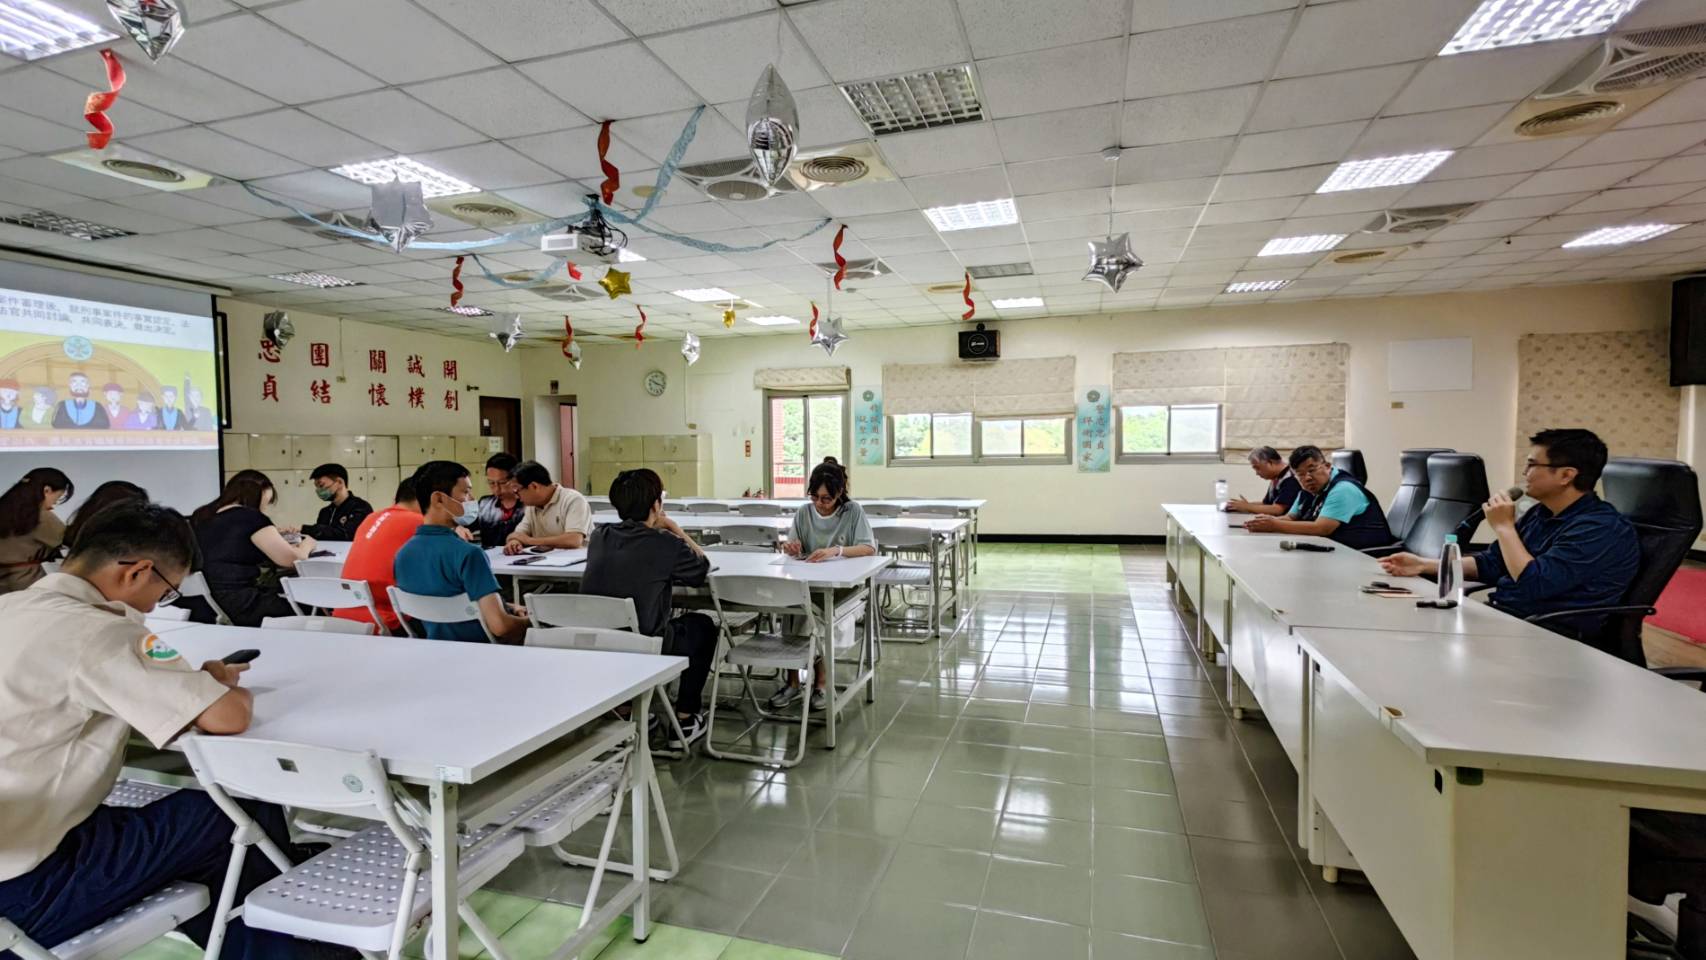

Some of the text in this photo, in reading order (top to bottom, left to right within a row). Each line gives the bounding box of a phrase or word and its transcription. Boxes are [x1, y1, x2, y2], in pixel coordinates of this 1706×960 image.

[258, 339, 281, 403] 忠貞
[310, 342, 331, 404] 團結
[368, 349, 389, 407] 關懷
[406, 354, 425, 409] 誠樸
[443, 360, 459, 411] 開創
